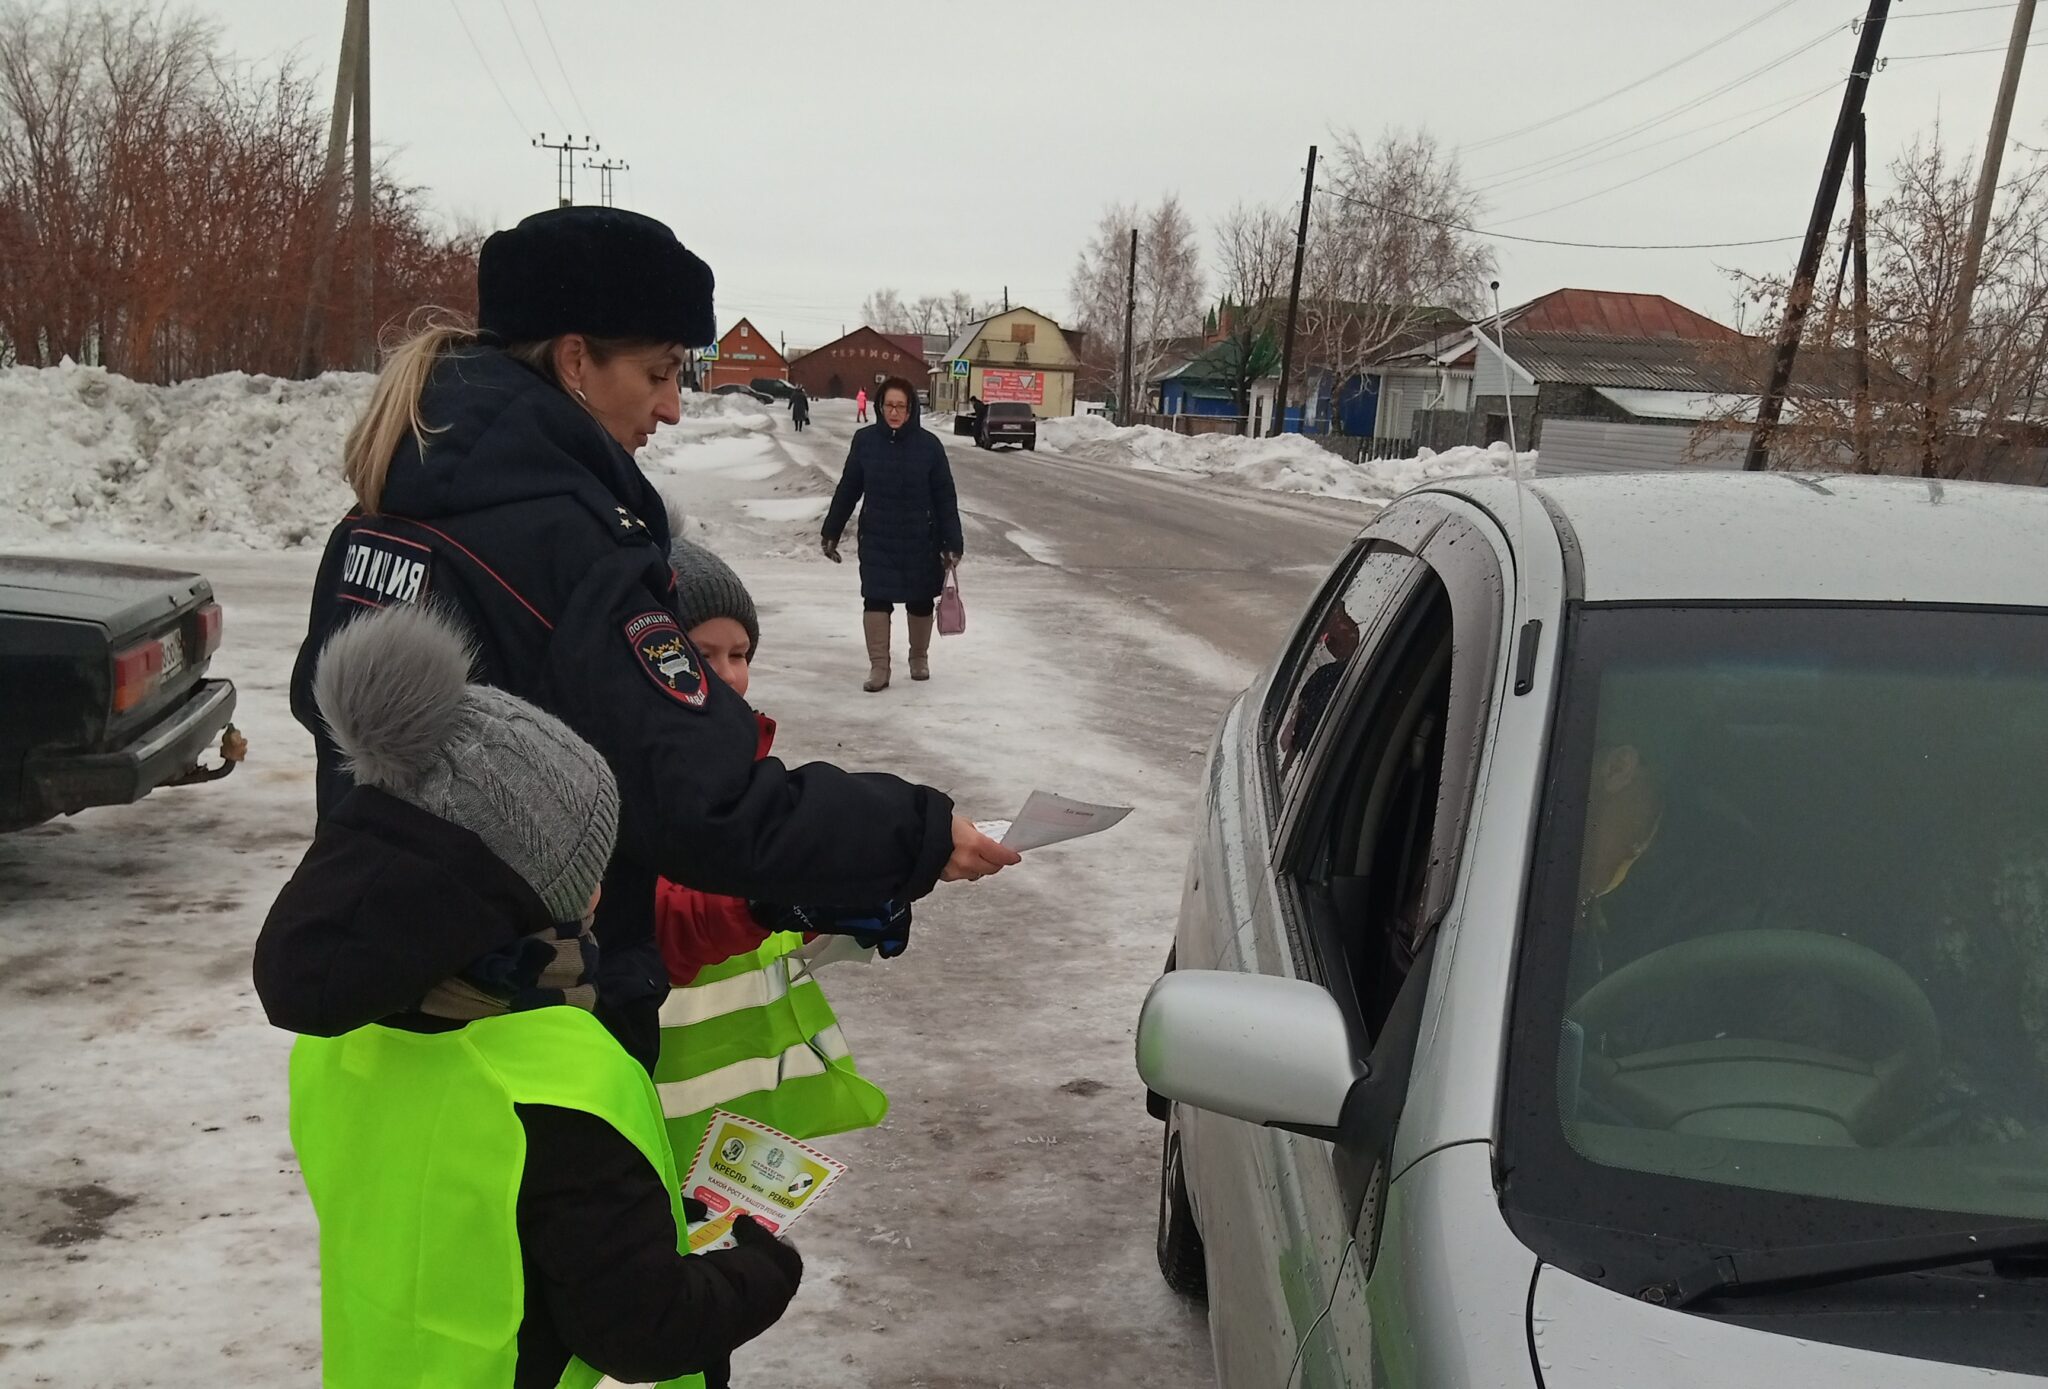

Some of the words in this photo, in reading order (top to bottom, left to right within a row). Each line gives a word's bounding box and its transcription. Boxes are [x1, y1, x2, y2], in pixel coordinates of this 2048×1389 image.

[343, 544, 425, 604] ОЛИЦИЯ
[628, 614, 672, 637] ПОЛИЦИЯ
[685, 688, 706, 706] МВД
[707, 1176, 727, 1189] КАКОЙ
[726, 1186, 742, 1197] РОСТ
[713, 1161, 747, 1184] КРЕСЛО
[751, 1183, 764, 1193] ИЛИ
[768, 1191, 797, 1208] РЕМЕНЬ
